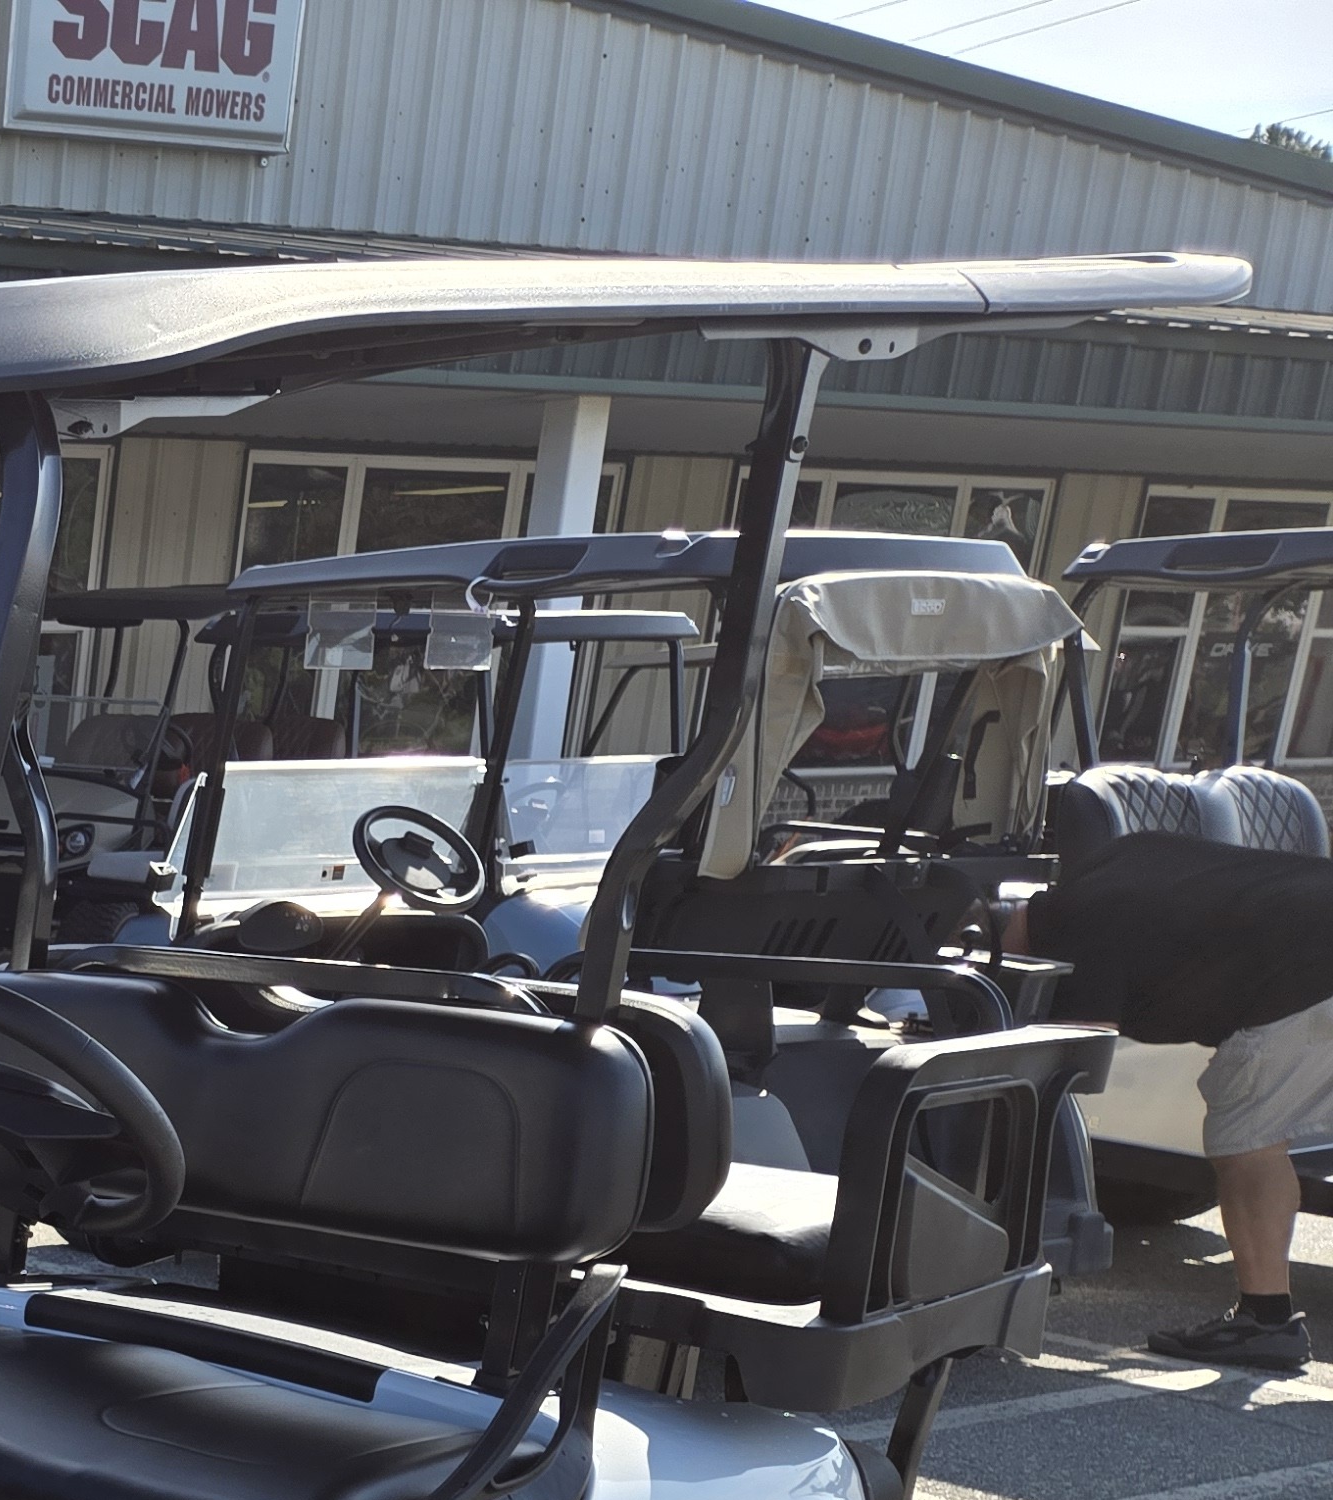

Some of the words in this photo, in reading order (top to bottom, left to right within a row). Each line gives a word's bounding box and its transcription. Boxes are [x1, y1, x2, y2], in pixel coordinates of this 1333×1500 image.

[52, 0, 276, 76] SCAG
[47, 73, 176, 115] COMMERCIAL
[184, 86, 266, 123] MOWERS
